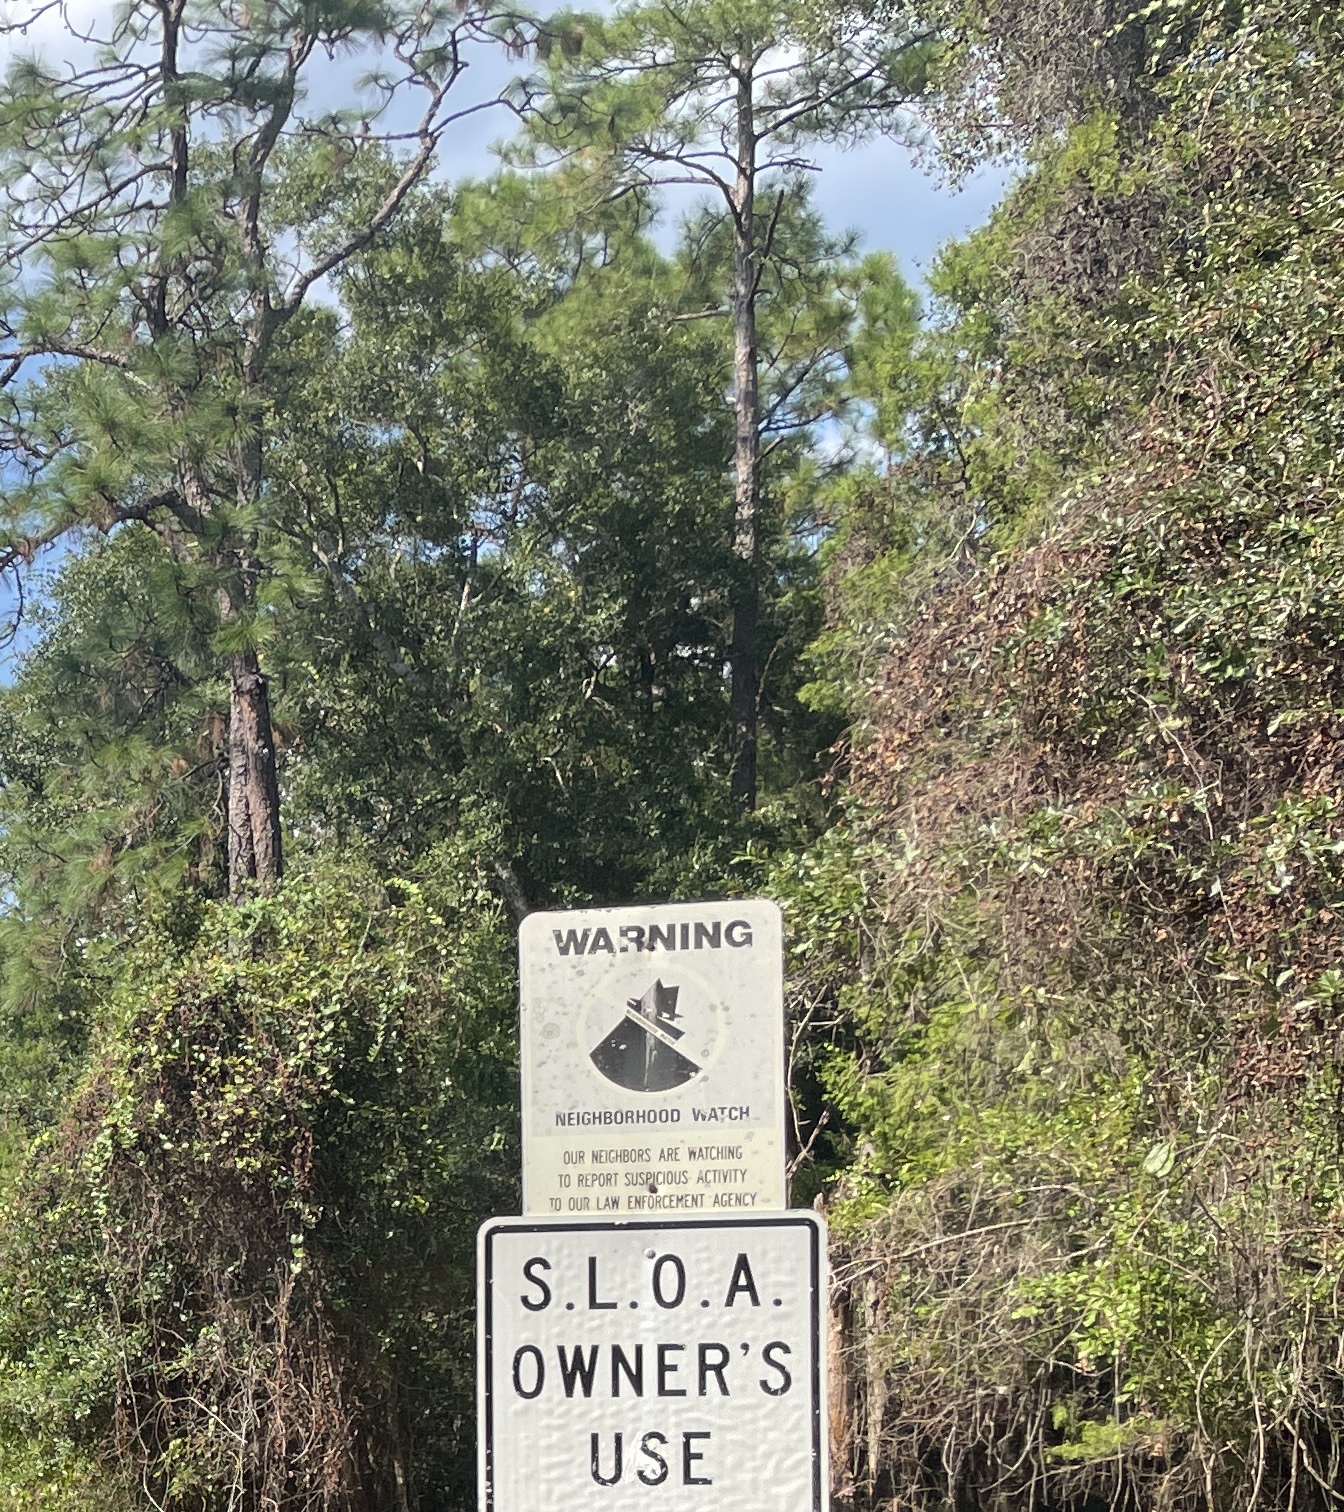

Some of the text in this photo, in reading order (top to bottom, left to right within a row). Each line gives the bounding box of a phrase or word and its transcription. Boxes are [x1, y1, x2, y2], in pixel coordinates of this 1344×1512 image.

[553, 920, 753, 956] WARNING
[555, 1106, 750, 1127] NEIGHBORHOOD WATCH
[563, 1145, 743, 1165] OUR NEIGHBORS ARE WATCHING
[558, 1168, 748, 1188] TO REPORT SUSPICIOUS ACTIVITY
[549, 1192, 757, 1211] TO OUR LAW ENFORCEMENT AGENCY
[520, 1253, 783, 1312] S.L.O.A.
[512, 1341, 792, 1400] OWNER'S
[590, 1431, 713, 1486] USE
